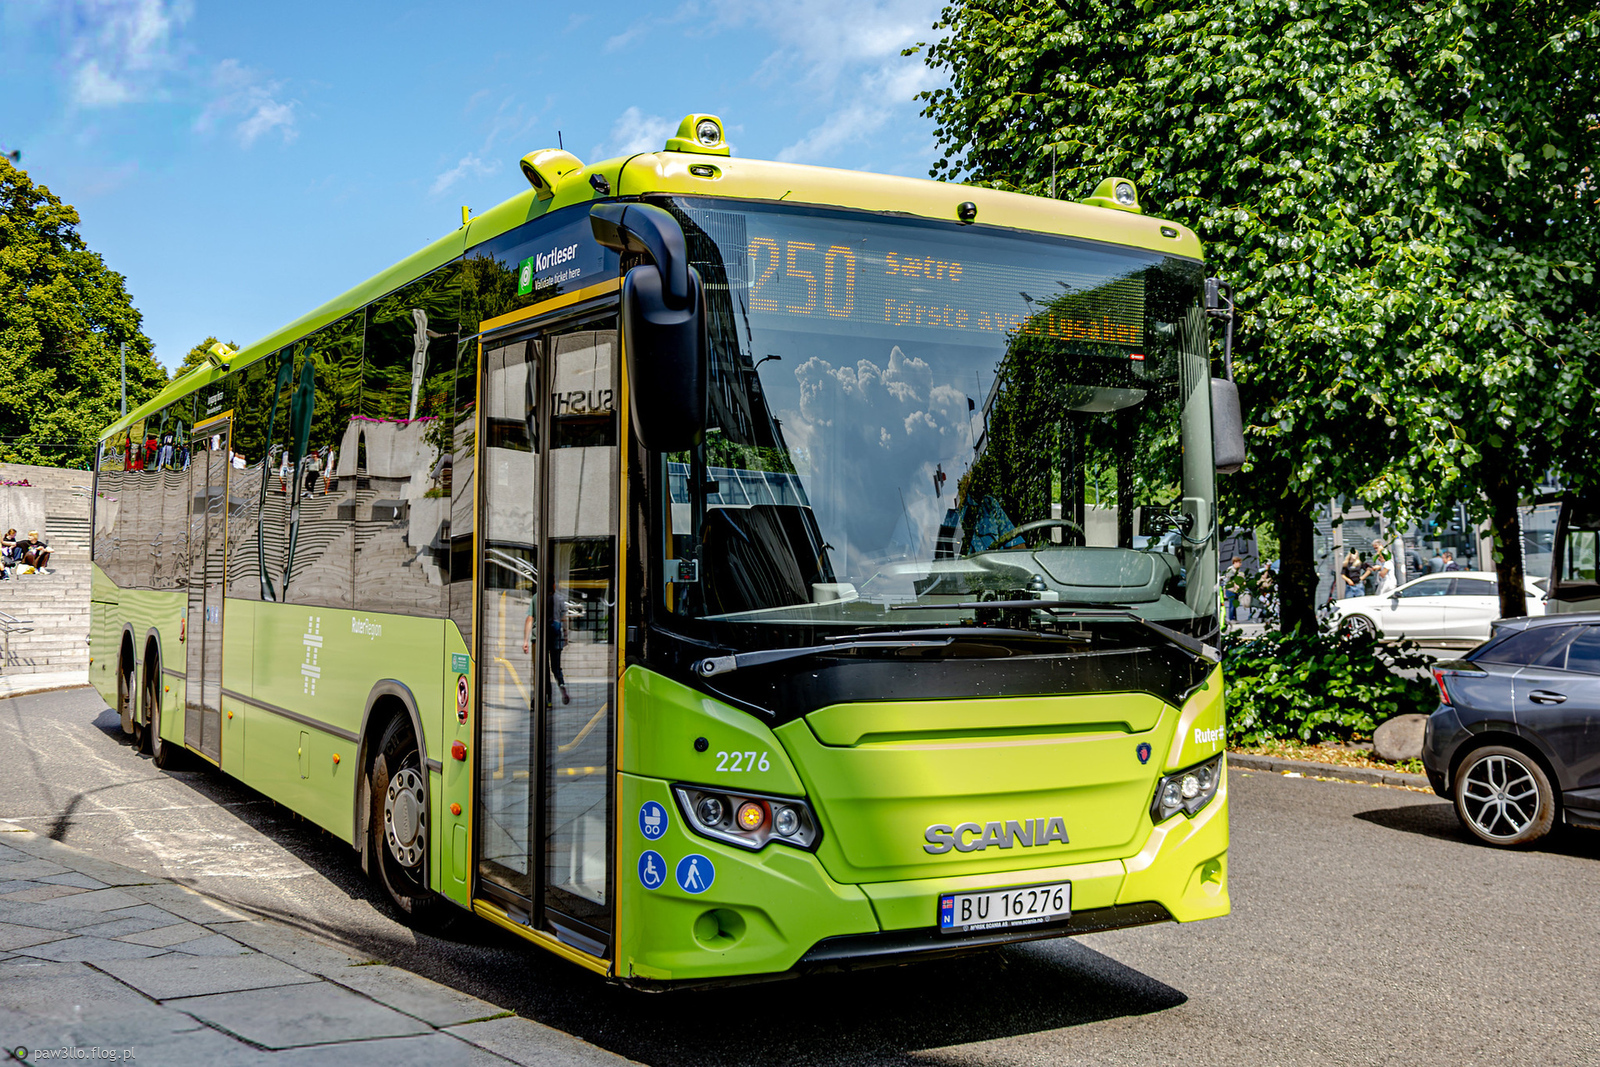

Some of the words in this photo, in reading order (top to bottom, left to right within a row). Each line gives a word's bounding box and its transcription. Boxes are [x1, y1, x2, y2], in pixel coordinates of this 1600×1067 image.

[535, 243, 578, 272] Kortleser
[885, 251, 963, 282] Sætre
[534, 276, 554, 291] Validate
[554, 270, 568, 284] ticket
[568, 267, 581, 279] here
[748, 237, 856, 318] 250
[885, 298, 969, 328] Første
[1048, 313, 1140, 342] Lysaker
[716, 751, 770, 772] 2276
[923, 816, 1070, 855] SCANIA
[943, 914, 951, 923] N
[961, 896, 990, 921] BU
[1001, 888, 1063, 917] 16276
